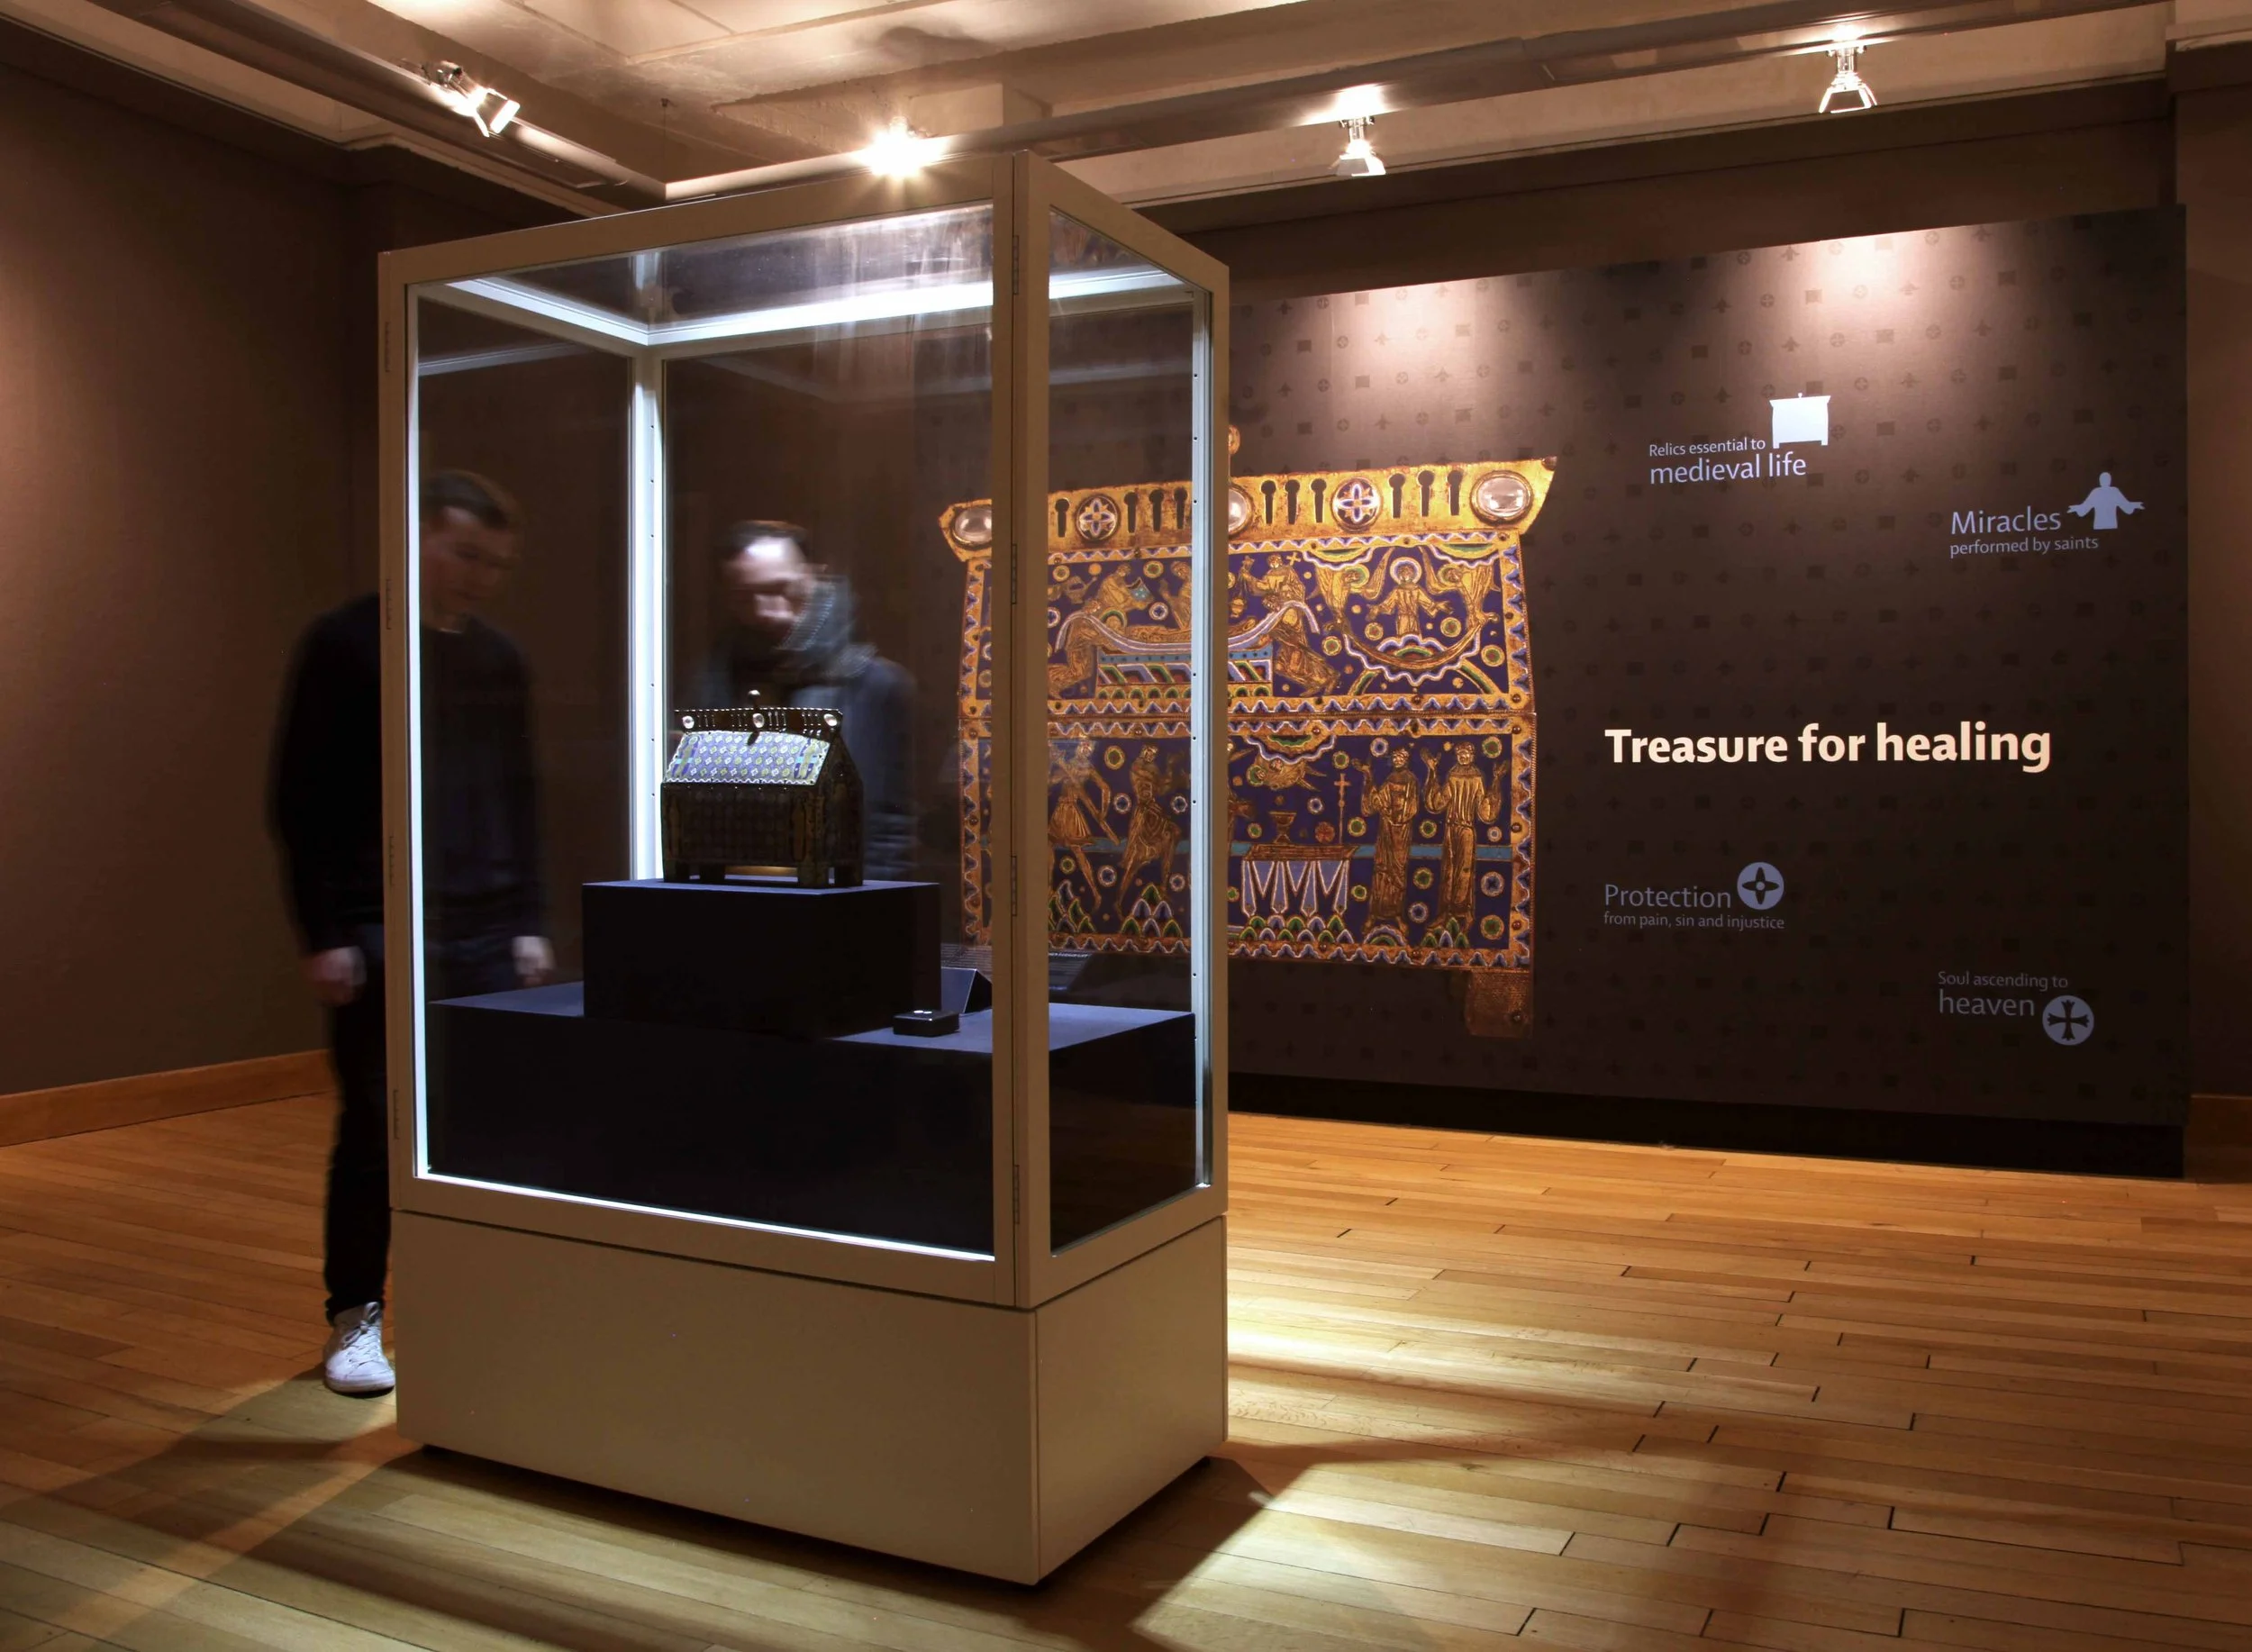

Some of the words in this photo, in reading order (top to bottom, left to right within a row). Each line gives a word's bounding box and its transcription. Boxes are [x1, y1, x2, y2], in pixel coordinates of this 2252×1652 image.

[1649, 442, 1685, 456] Relics
[1689, 437, 1748, 453] essential
[1750, 438, 1766, 450] to
[1650, 455, 1760, 484] medieval
[1768, 451, 1806, 477] life
[1951, 506, 2061, 534] Miracles
[1949, 538, 2029, 558] performed
[2032, 536, 2051, 554] by
[2054, 536, 2099, 549] saints
[1605, 730, 1788, 763] Treasure
[1797, 723, 1866, 762] for
[1876, 721, 2050, 773] healing
[1605, 885, 1731, 909] Protection
[1603, 911, 1636, 925] from
[1639, 913, 1672, 930] pain,
[1675, 913, 1694, 927] sin
[1697, 913, 1724, 928] and
[1727, 914, 1784, 931] injustice
[1938, 970, 1970, 985] Soul
[1973, 973, 2048, 992] ascending
[2051, 976, 2069, 988] to
[1939, 988, 2035, 1017] heaven
